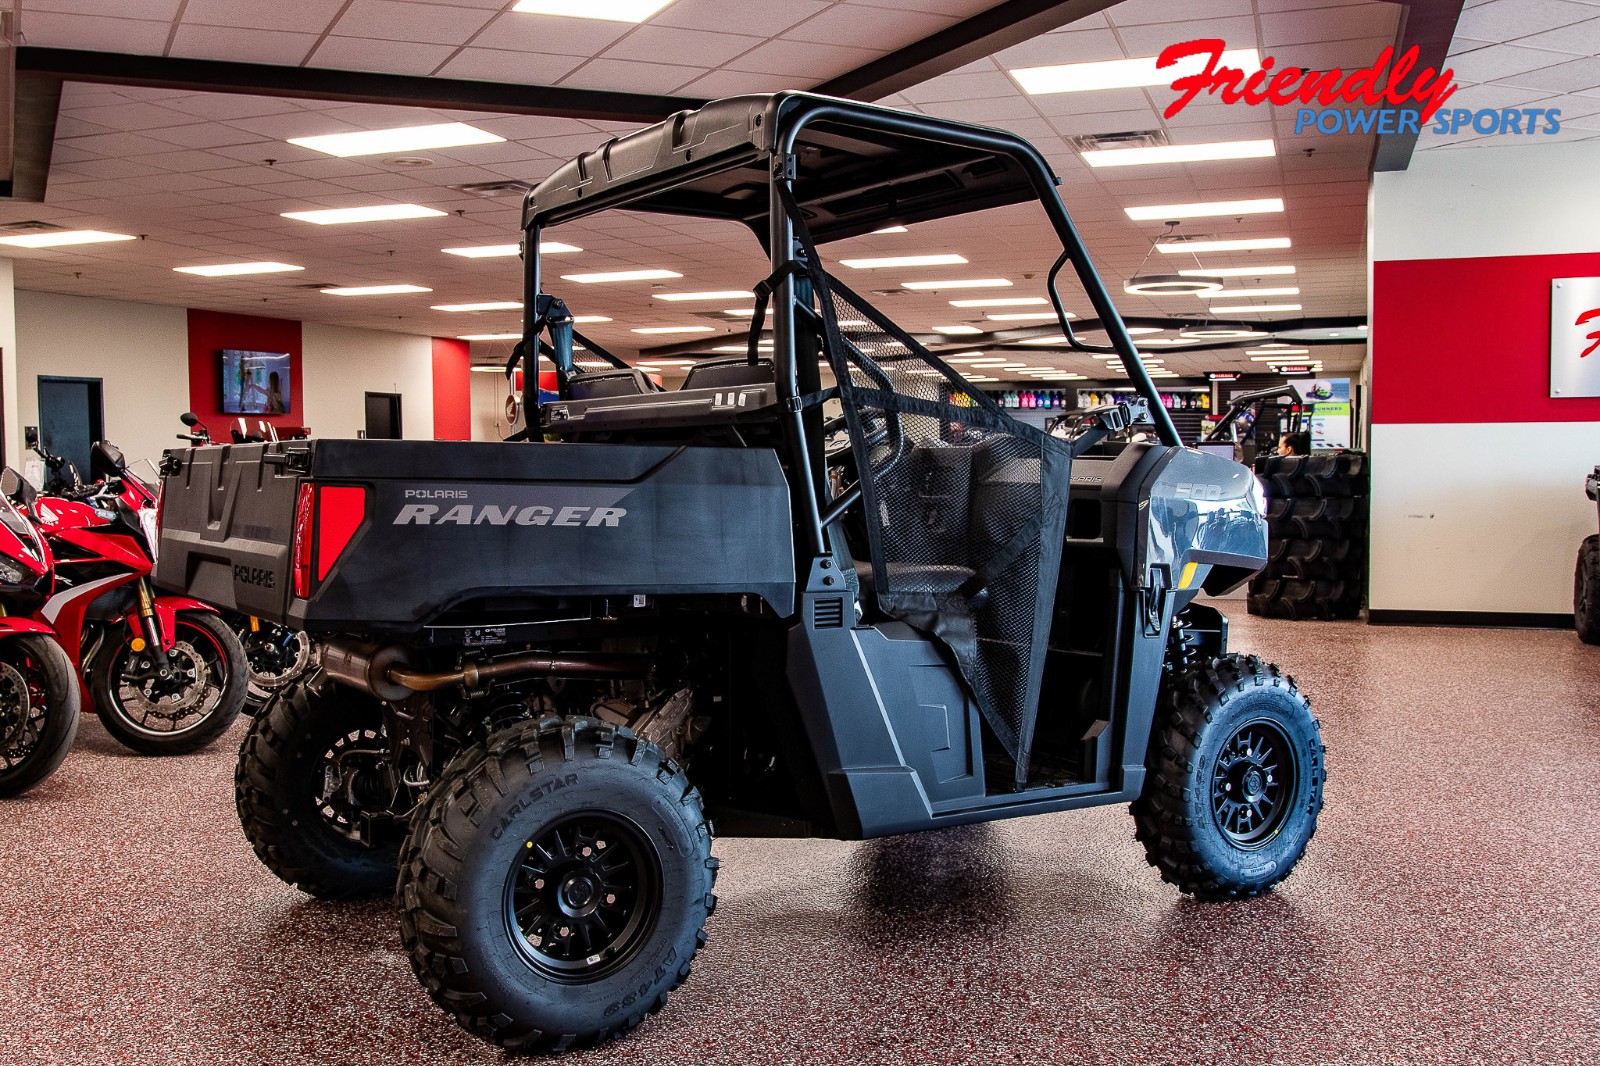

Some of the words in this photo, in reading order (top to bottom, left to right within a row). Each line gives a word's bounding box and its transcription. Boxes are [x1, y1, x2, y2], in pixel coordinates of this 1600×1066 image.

[405, 489, 468, 499] POLARIS
[1174, 482, 1221, 501] 500
[392, 504, 628, 527] RANGER
[234, 564, 276, 589] POLARIS
[1306, 738, 1319, 816] CARLSTAR
[489, 773, 579, 840] CARLSTAR
